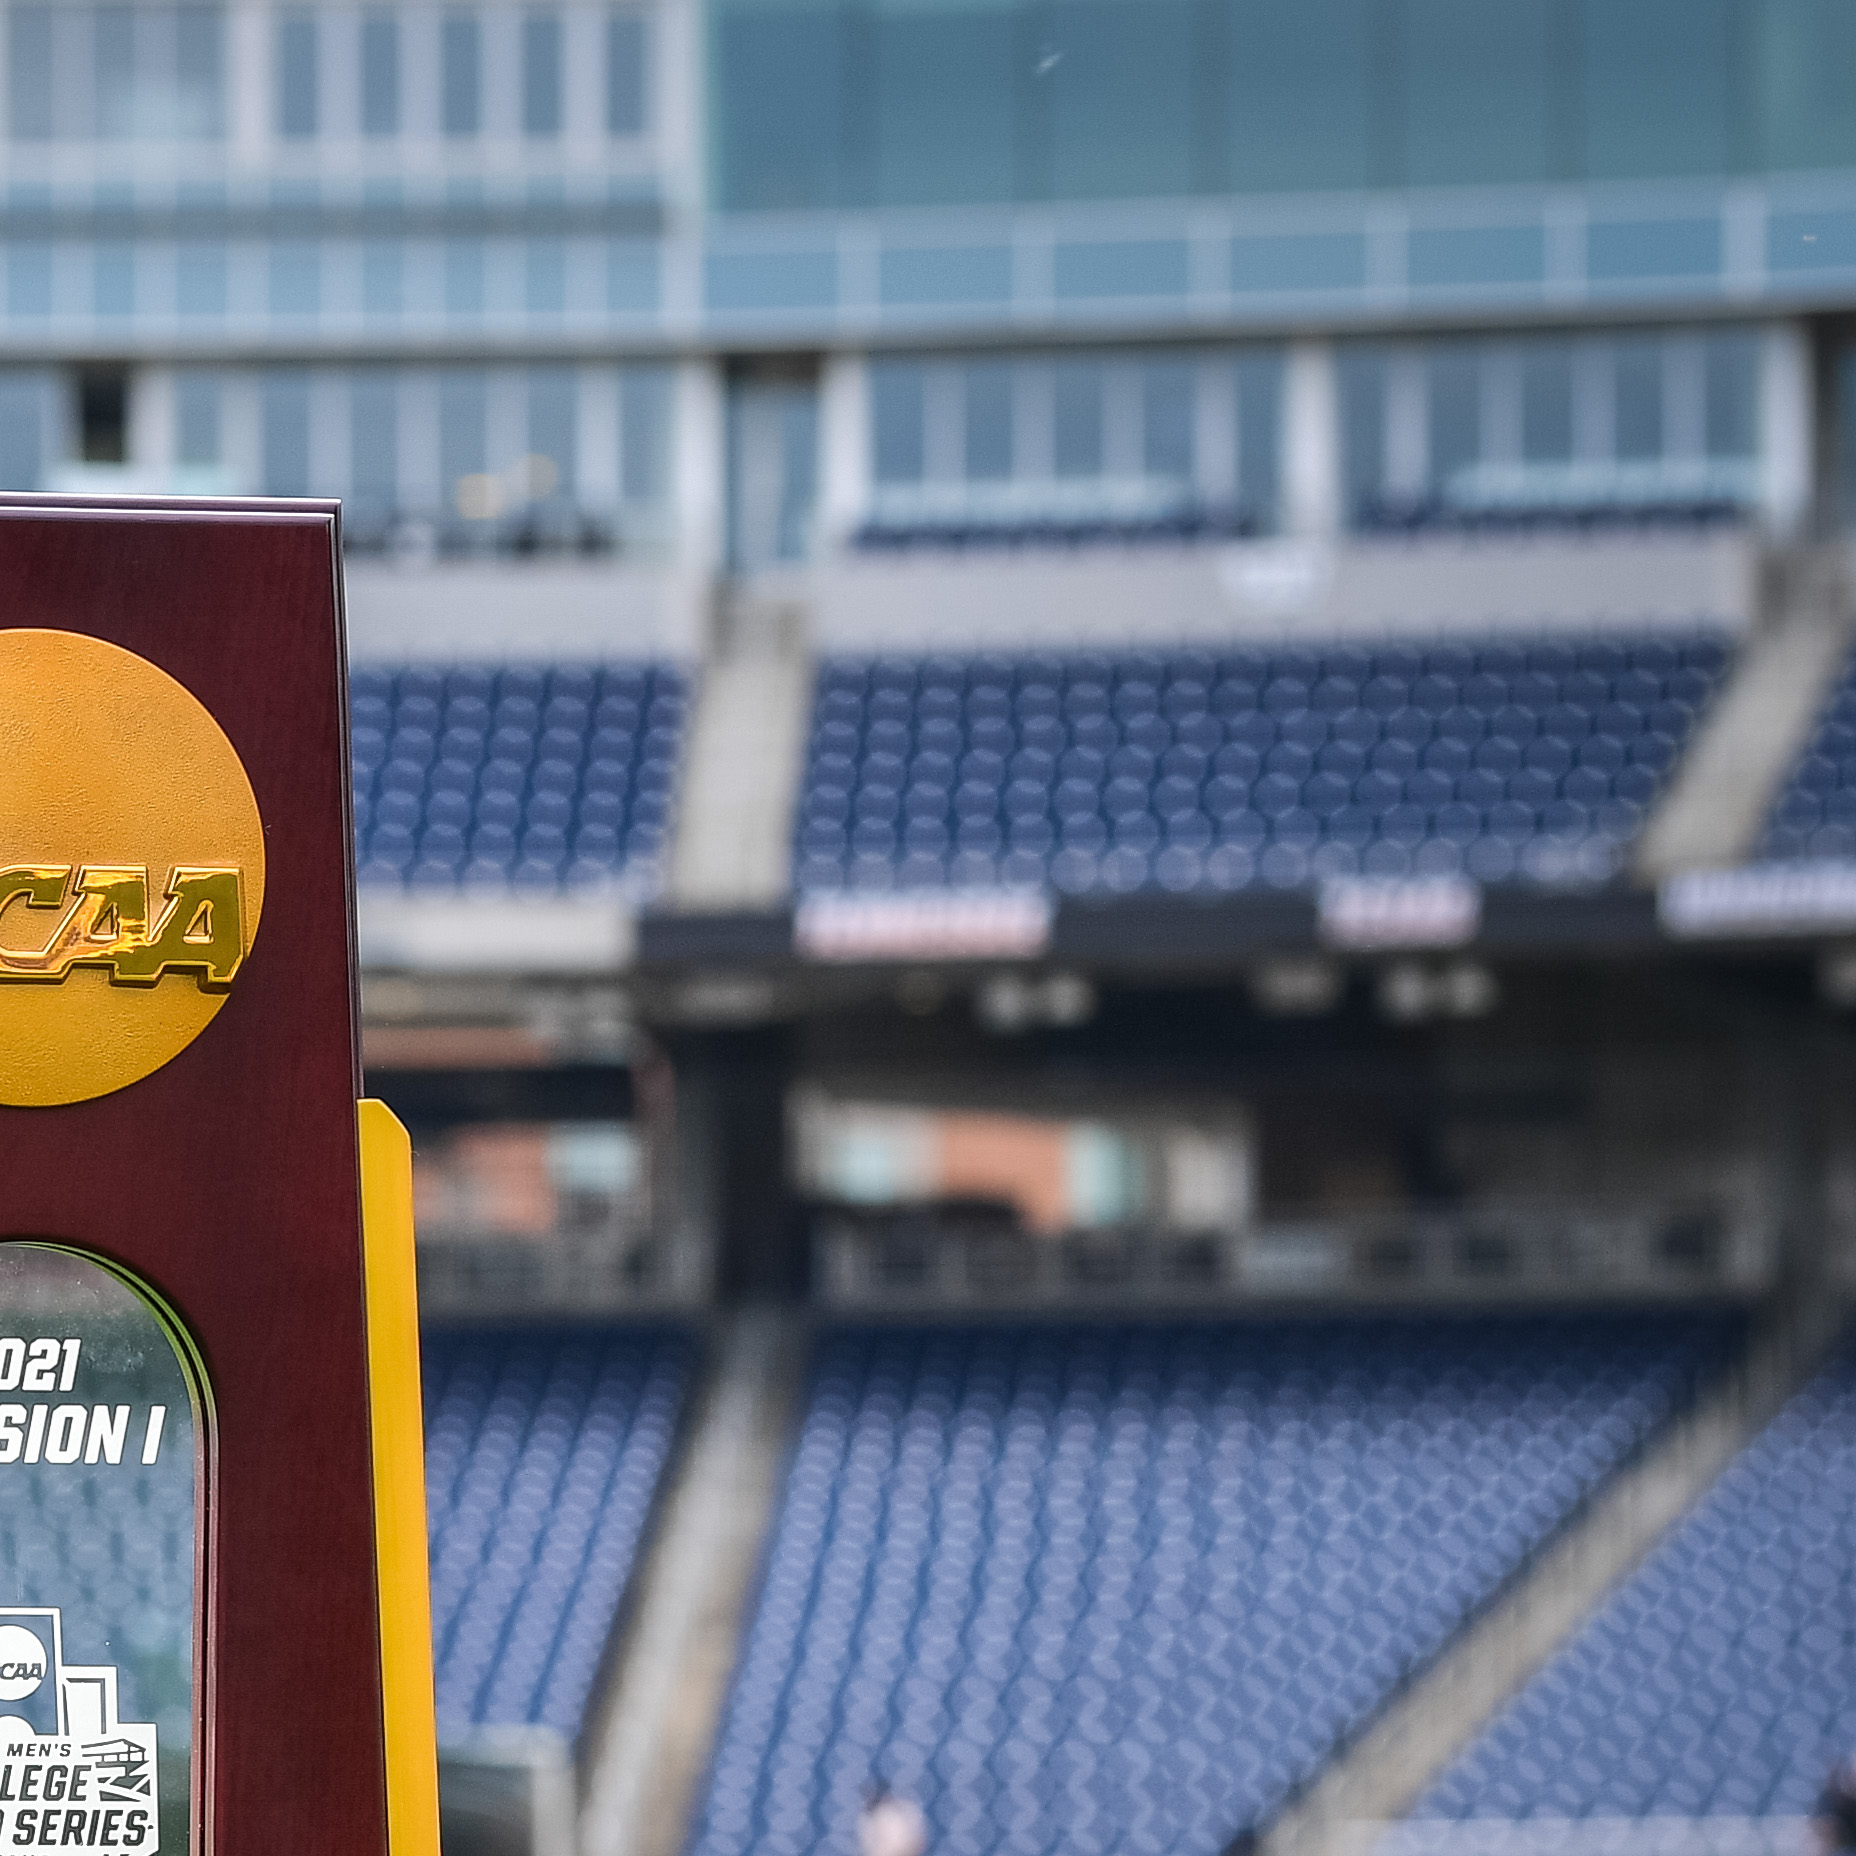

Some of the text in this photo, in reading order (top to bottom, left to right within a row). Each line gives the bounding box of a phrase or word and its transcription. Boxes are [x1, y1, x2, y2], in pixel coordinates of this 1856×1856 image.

[141, 1404, 167, 1465] I
[7, 1743, 72, 1757] MEN'S
[12, 1809, 149, 1847] SERIES
